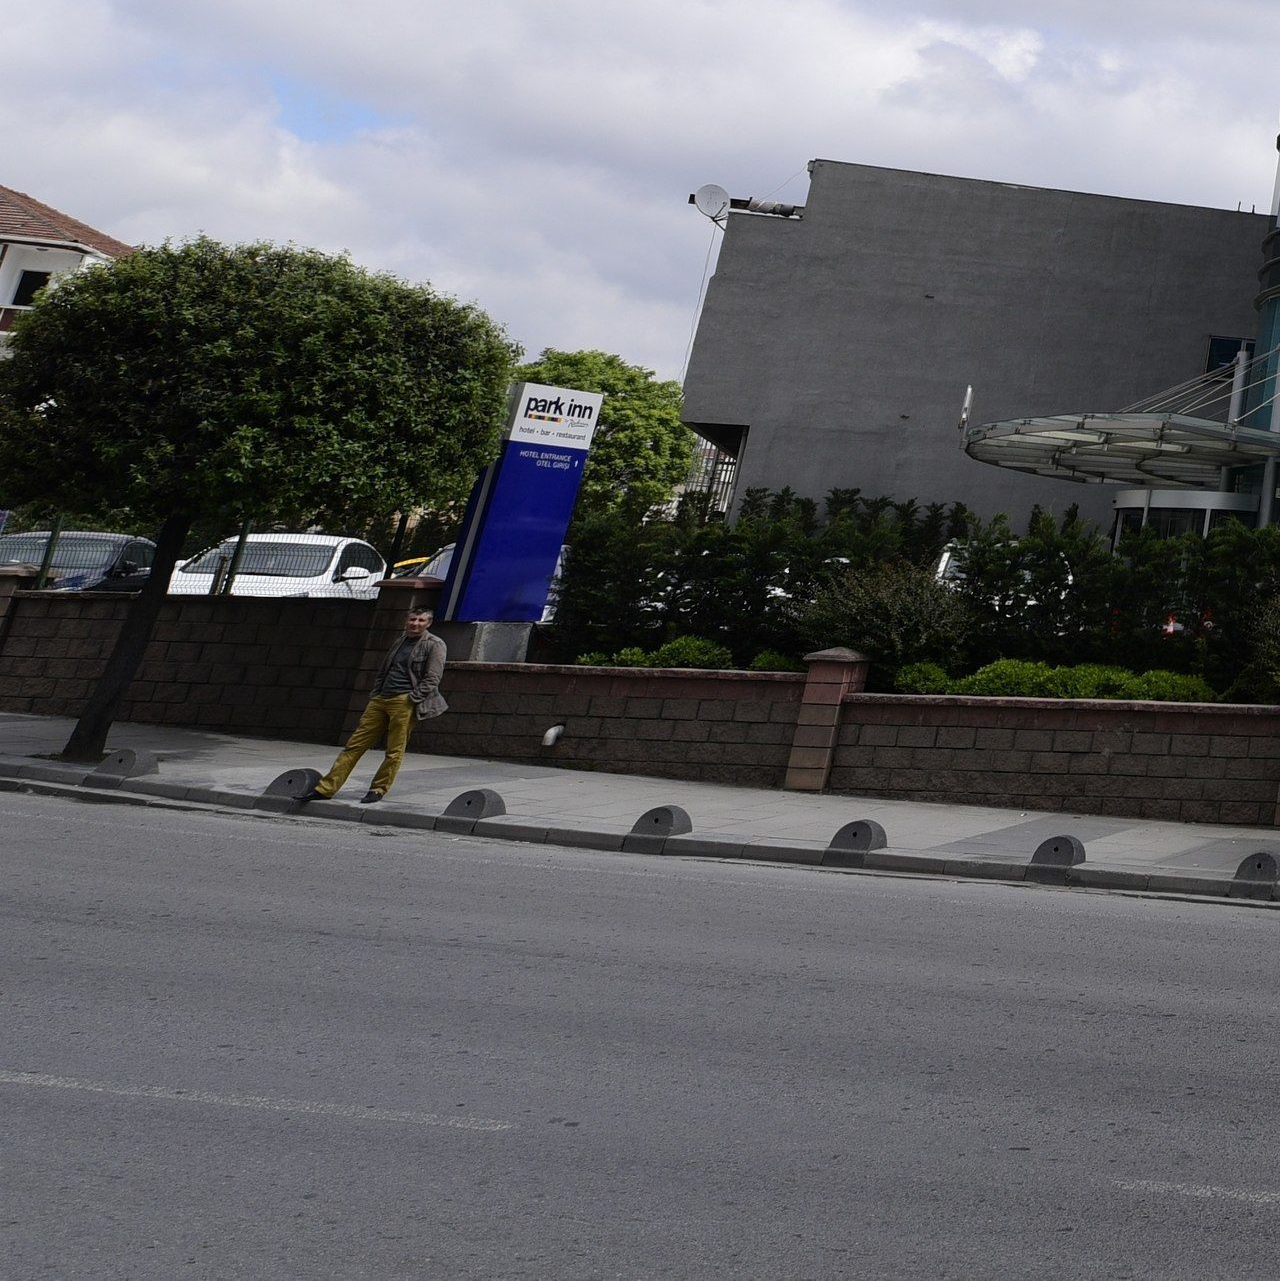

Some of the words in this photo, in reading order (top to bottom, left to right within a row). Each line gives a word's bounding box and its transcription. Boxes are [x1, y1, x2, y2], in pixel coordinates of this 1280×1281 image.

[524, 396, 566, 418] park
[567, 398, 594, 420] inn
[518, 426, 536, 434] hotel
[555, 432, 587, 441] restaurant
[519, 450, 539, 459] HOTEL
[540, 452, 572, 462] ENTRANCE
[536, 460, 552, 468] OTEL
